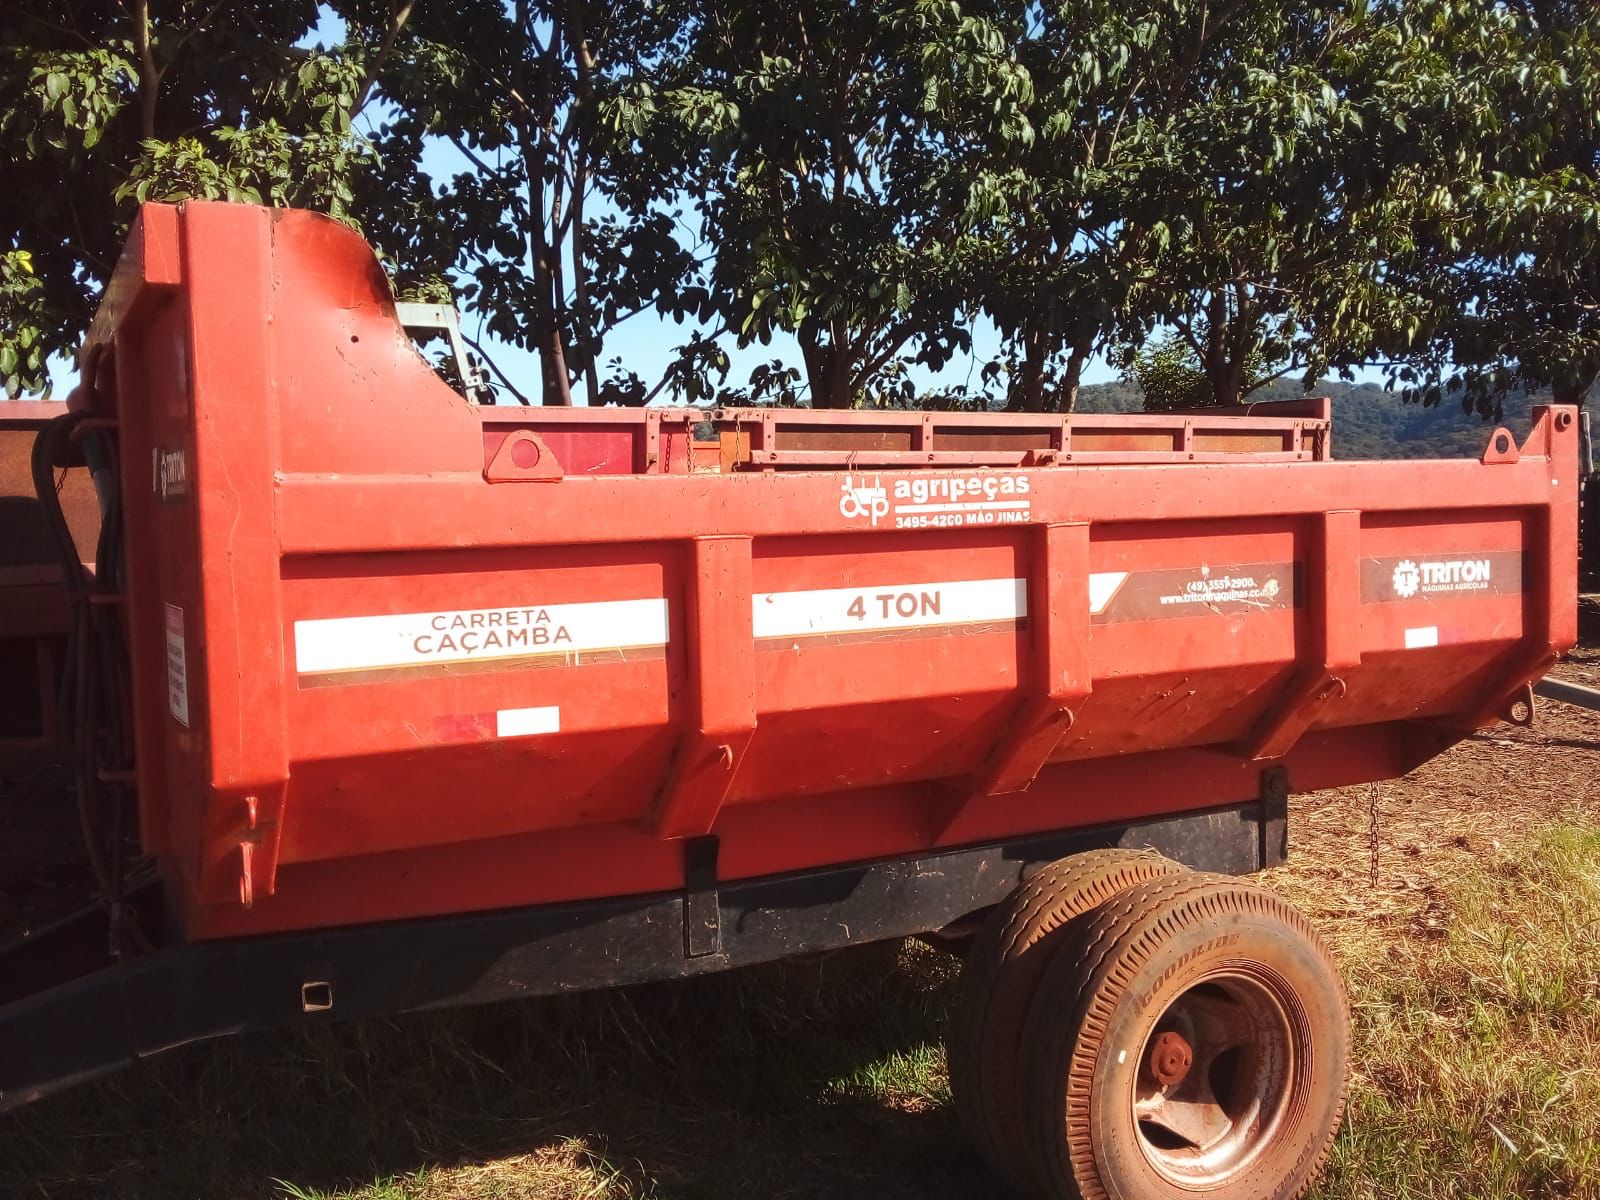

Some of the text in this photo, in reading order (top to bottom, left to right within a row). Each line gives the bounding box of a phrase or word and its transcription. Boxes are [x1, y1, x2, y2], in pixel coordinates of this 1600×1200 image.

[894, 475, 1030, 504] agripeças
[1420, 560, 1490, 583] TRITON
[1186, 580, 1208, 593] (49)
[846, 591, 941, 619] 4 TON
[431, 609, 551, 631] CARRETA
[413, 624, 573, 655] CAÇAMBA
